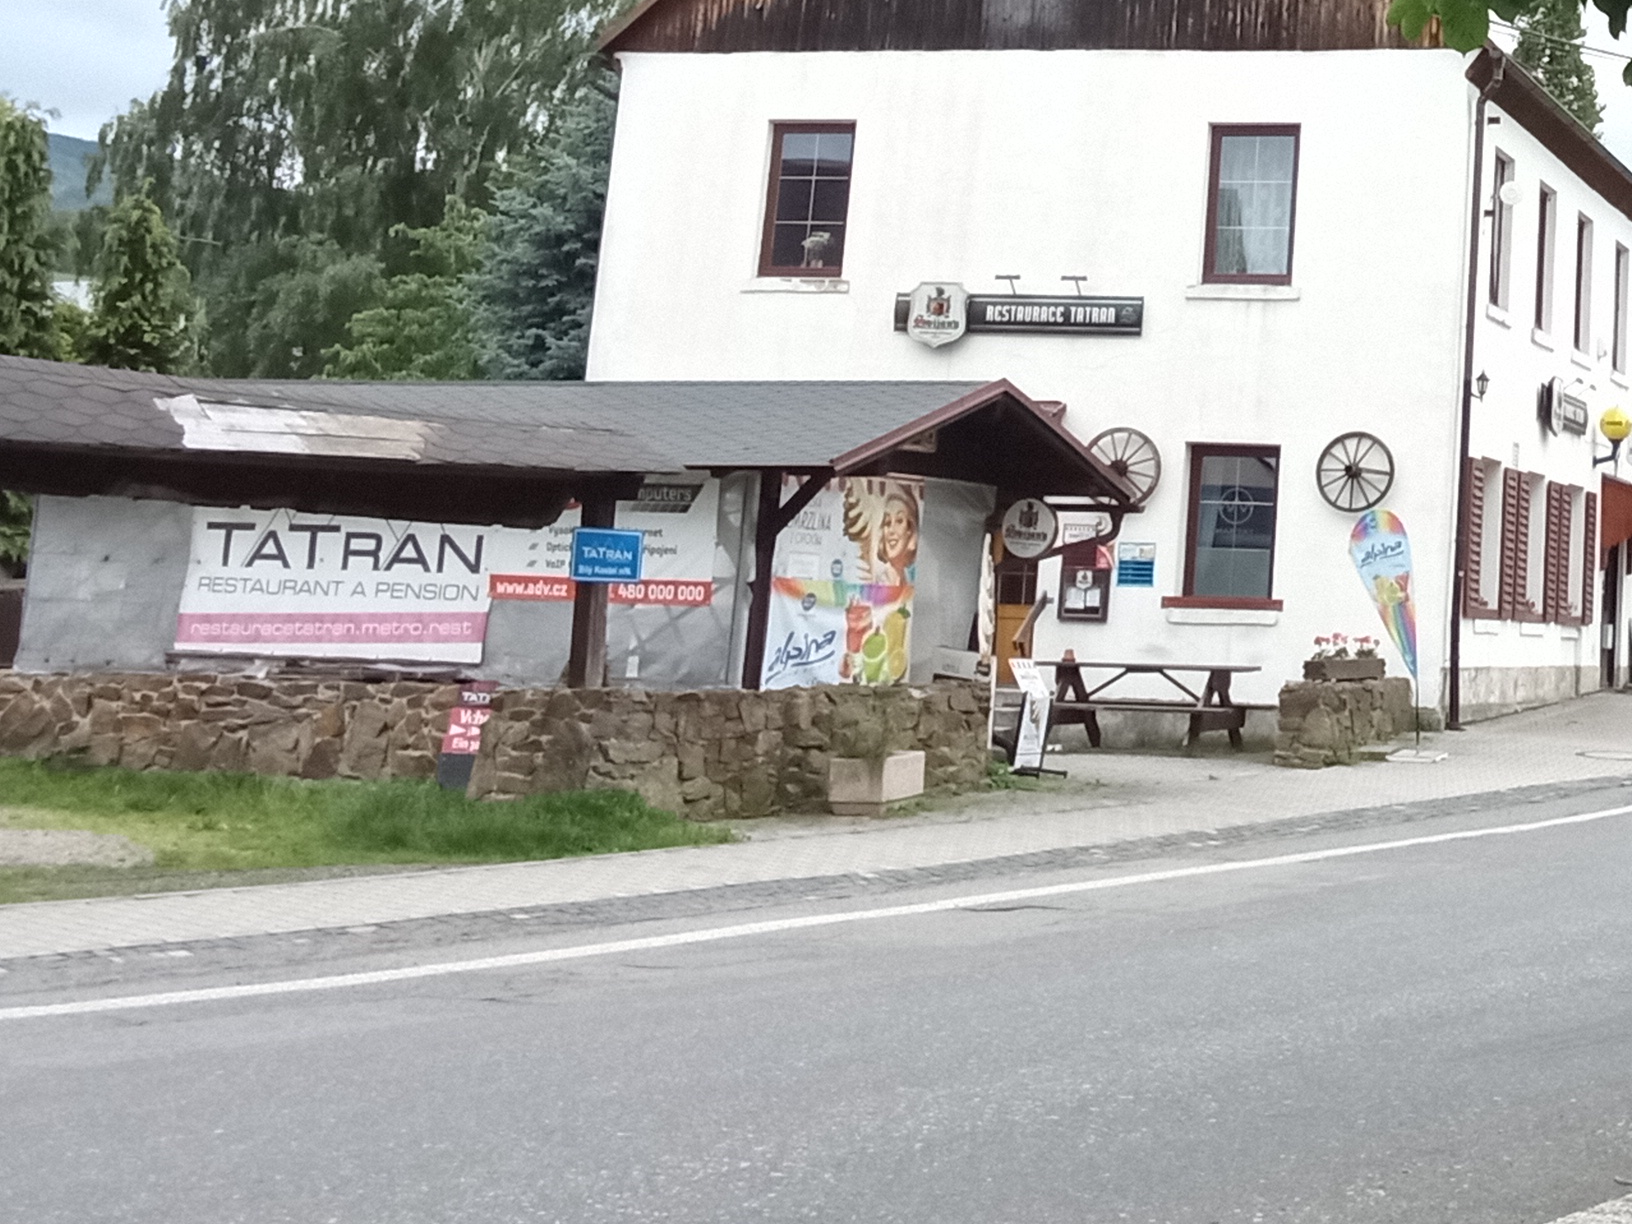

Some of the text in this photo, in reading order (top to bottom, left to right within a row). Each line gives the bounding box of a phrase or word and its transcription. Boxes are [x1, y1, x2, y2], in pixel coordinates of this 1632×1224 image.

[985, 304, 1116, 324] RESTAURACE TATRAN
[206, 521, 485, 575] TATRAN
[582, 546, 633, 561] TATRAN
[197, 577, 480, 602] RESTAURANT A PENSION
[618, 582, 646, 599] 480
[648, 584, 675, 600] 000
[677, 585, 705, 601] 000
